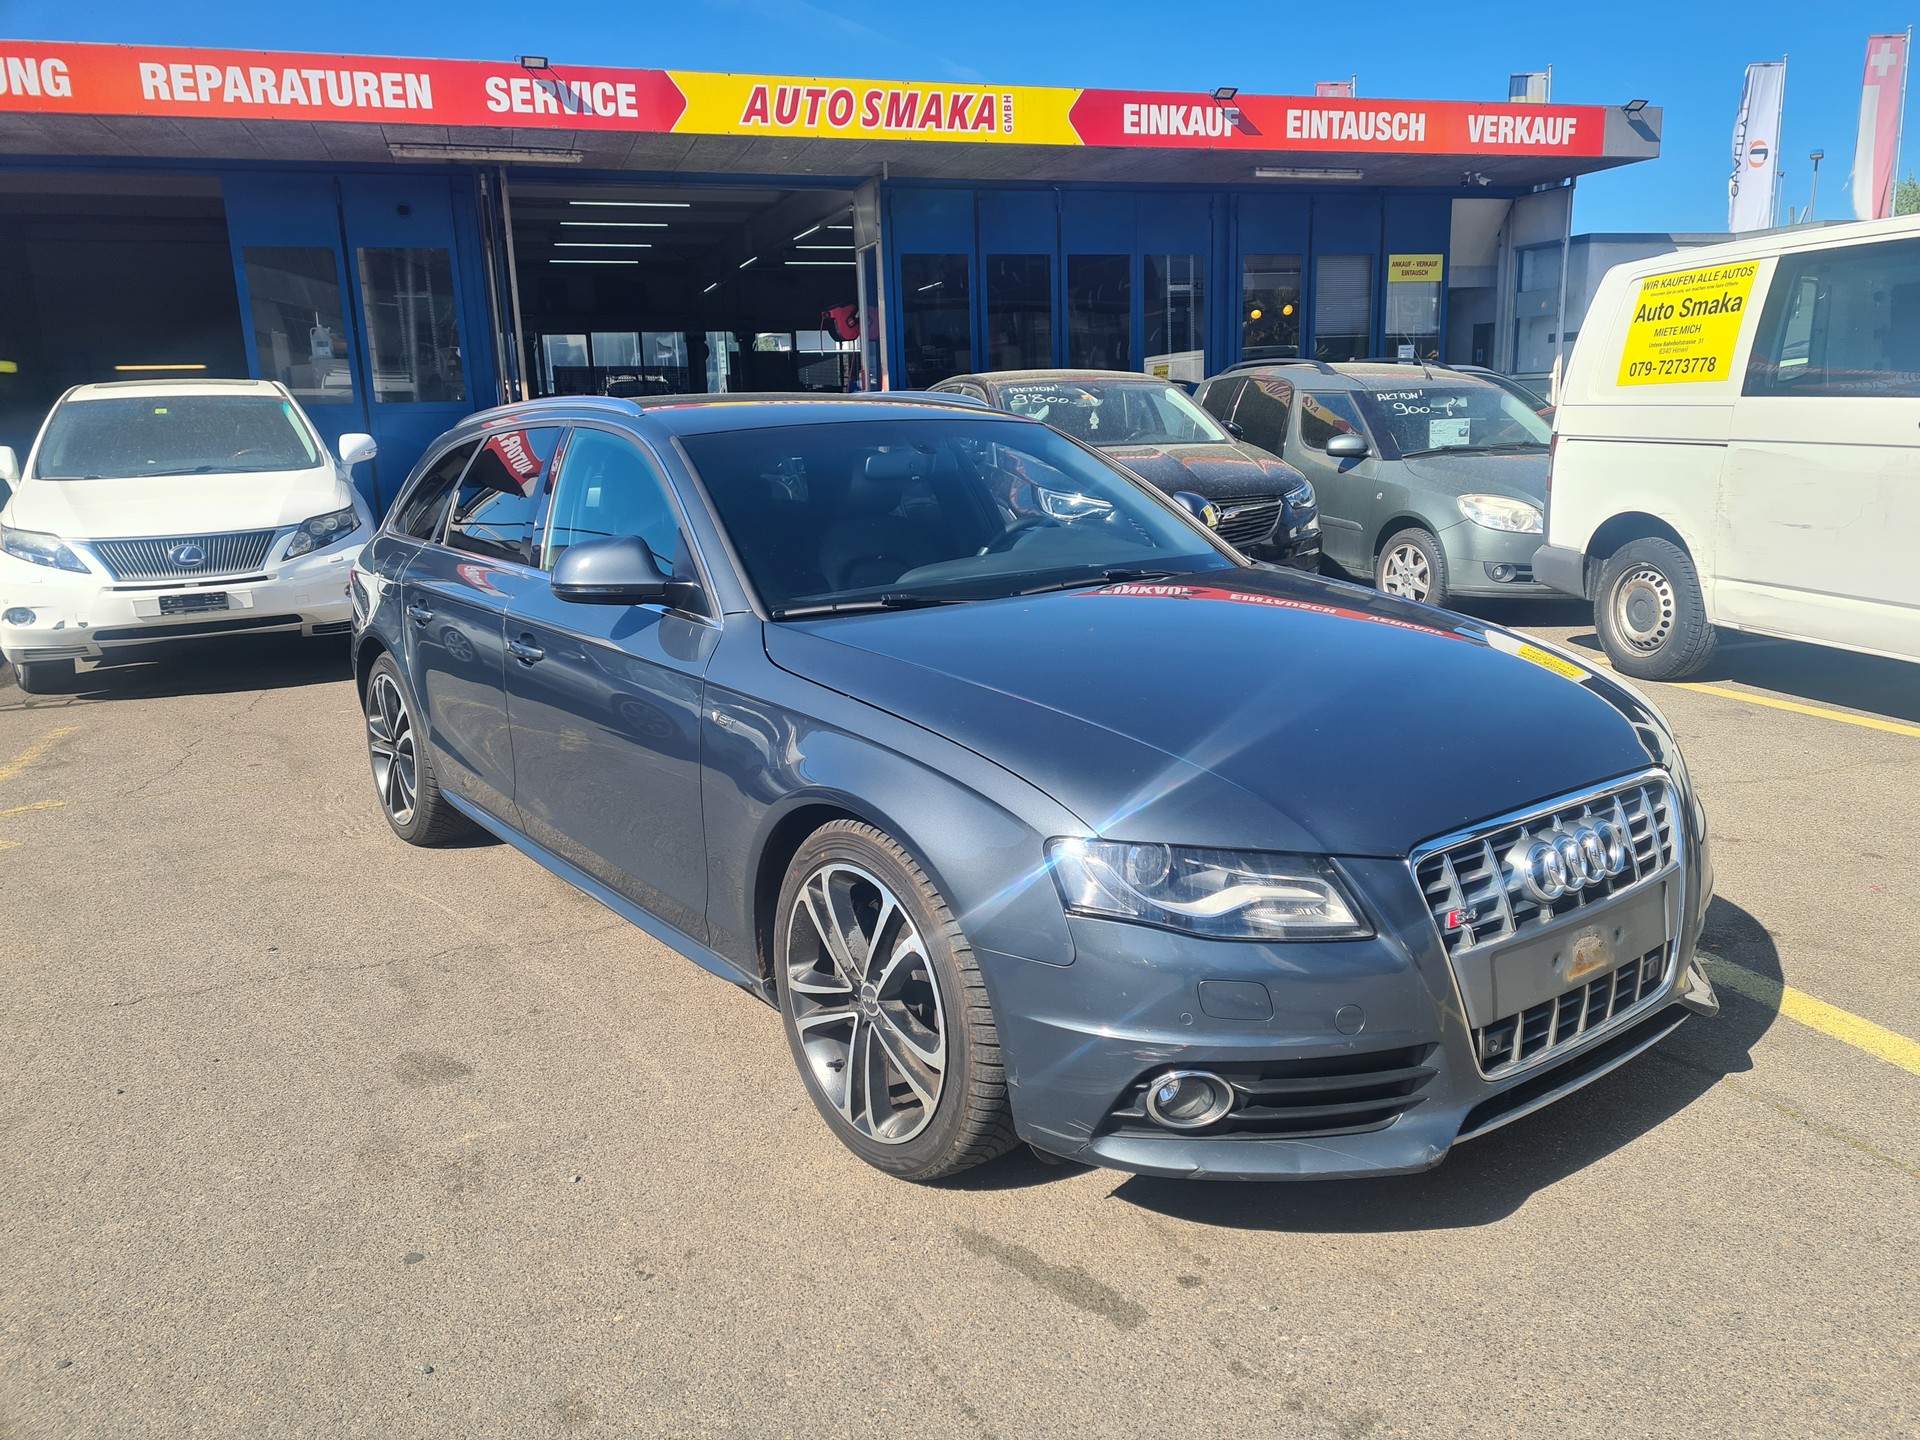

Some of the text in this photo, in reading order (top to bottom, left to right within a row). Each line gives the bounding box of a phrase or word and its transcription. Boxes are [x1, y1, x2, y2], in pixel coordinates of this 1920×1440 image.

[0, 57, 72, 98] NG
[138, 62, 433, 110] REPARATUREN
[485, 76, 639, 118] SERVICE
[740, 84, 998, 134] AUTO SMAKA
[1003, 94, 1013, 134] GMBH
[1123, 103, 1240, 137] EINKAUF
[1286, 108, 1426, 142] EINTAUSCH
[1468, 114, 1577, 145] VERKAUF
[1643, 265, 1755, 291] WIR KAUFEN ALLE AUTOS
[1634, 291, 1743, 323] Auto Smaka
[1653, 324, 1702, 337] MIETE MICH
[1629, 356, 1717, 377] 079-7273778
